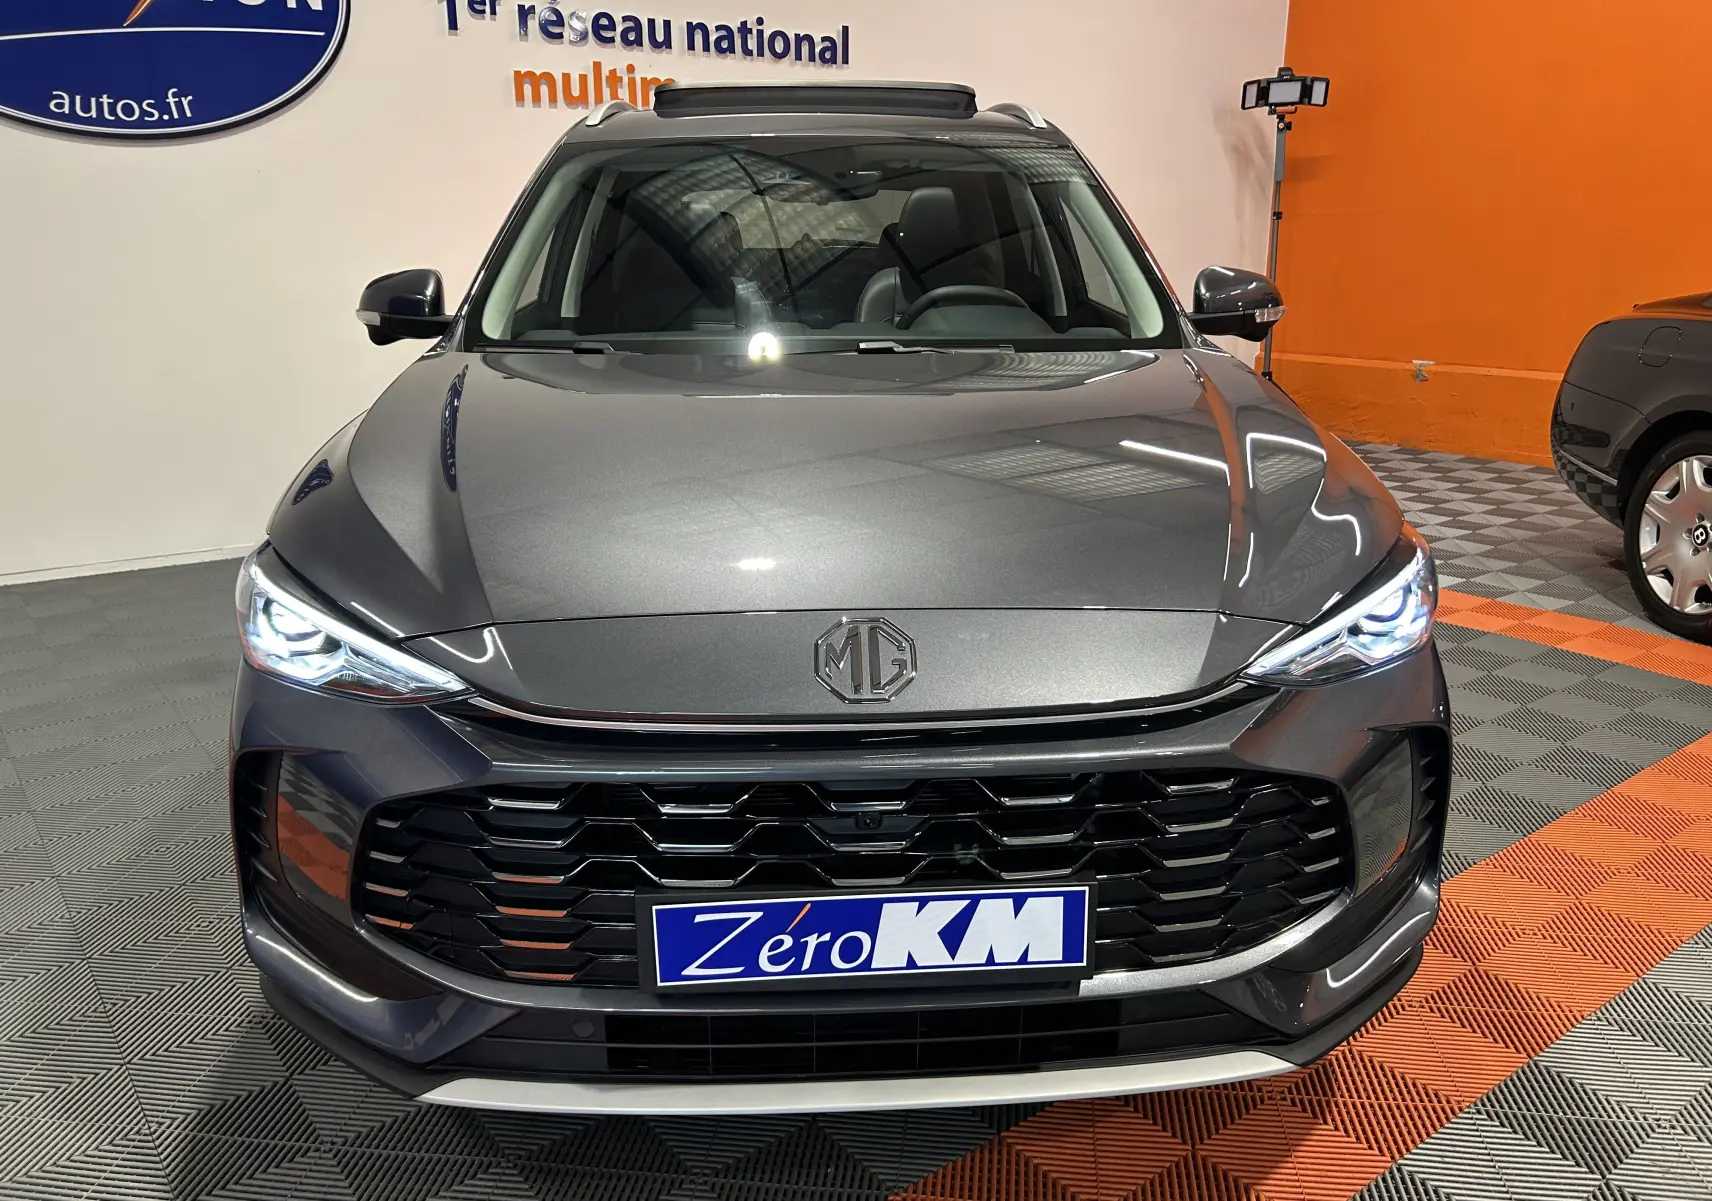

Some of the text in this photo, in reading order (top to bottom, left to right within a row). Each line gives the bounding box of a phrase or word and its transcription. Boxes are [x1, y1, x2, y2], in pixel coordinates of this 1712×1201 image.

[516, 0, 672, 49] réseau
[686, 17, 850, 65] national
[49, 88, 193, 121] autos.fr
[824, 624, 908, 696] MG
